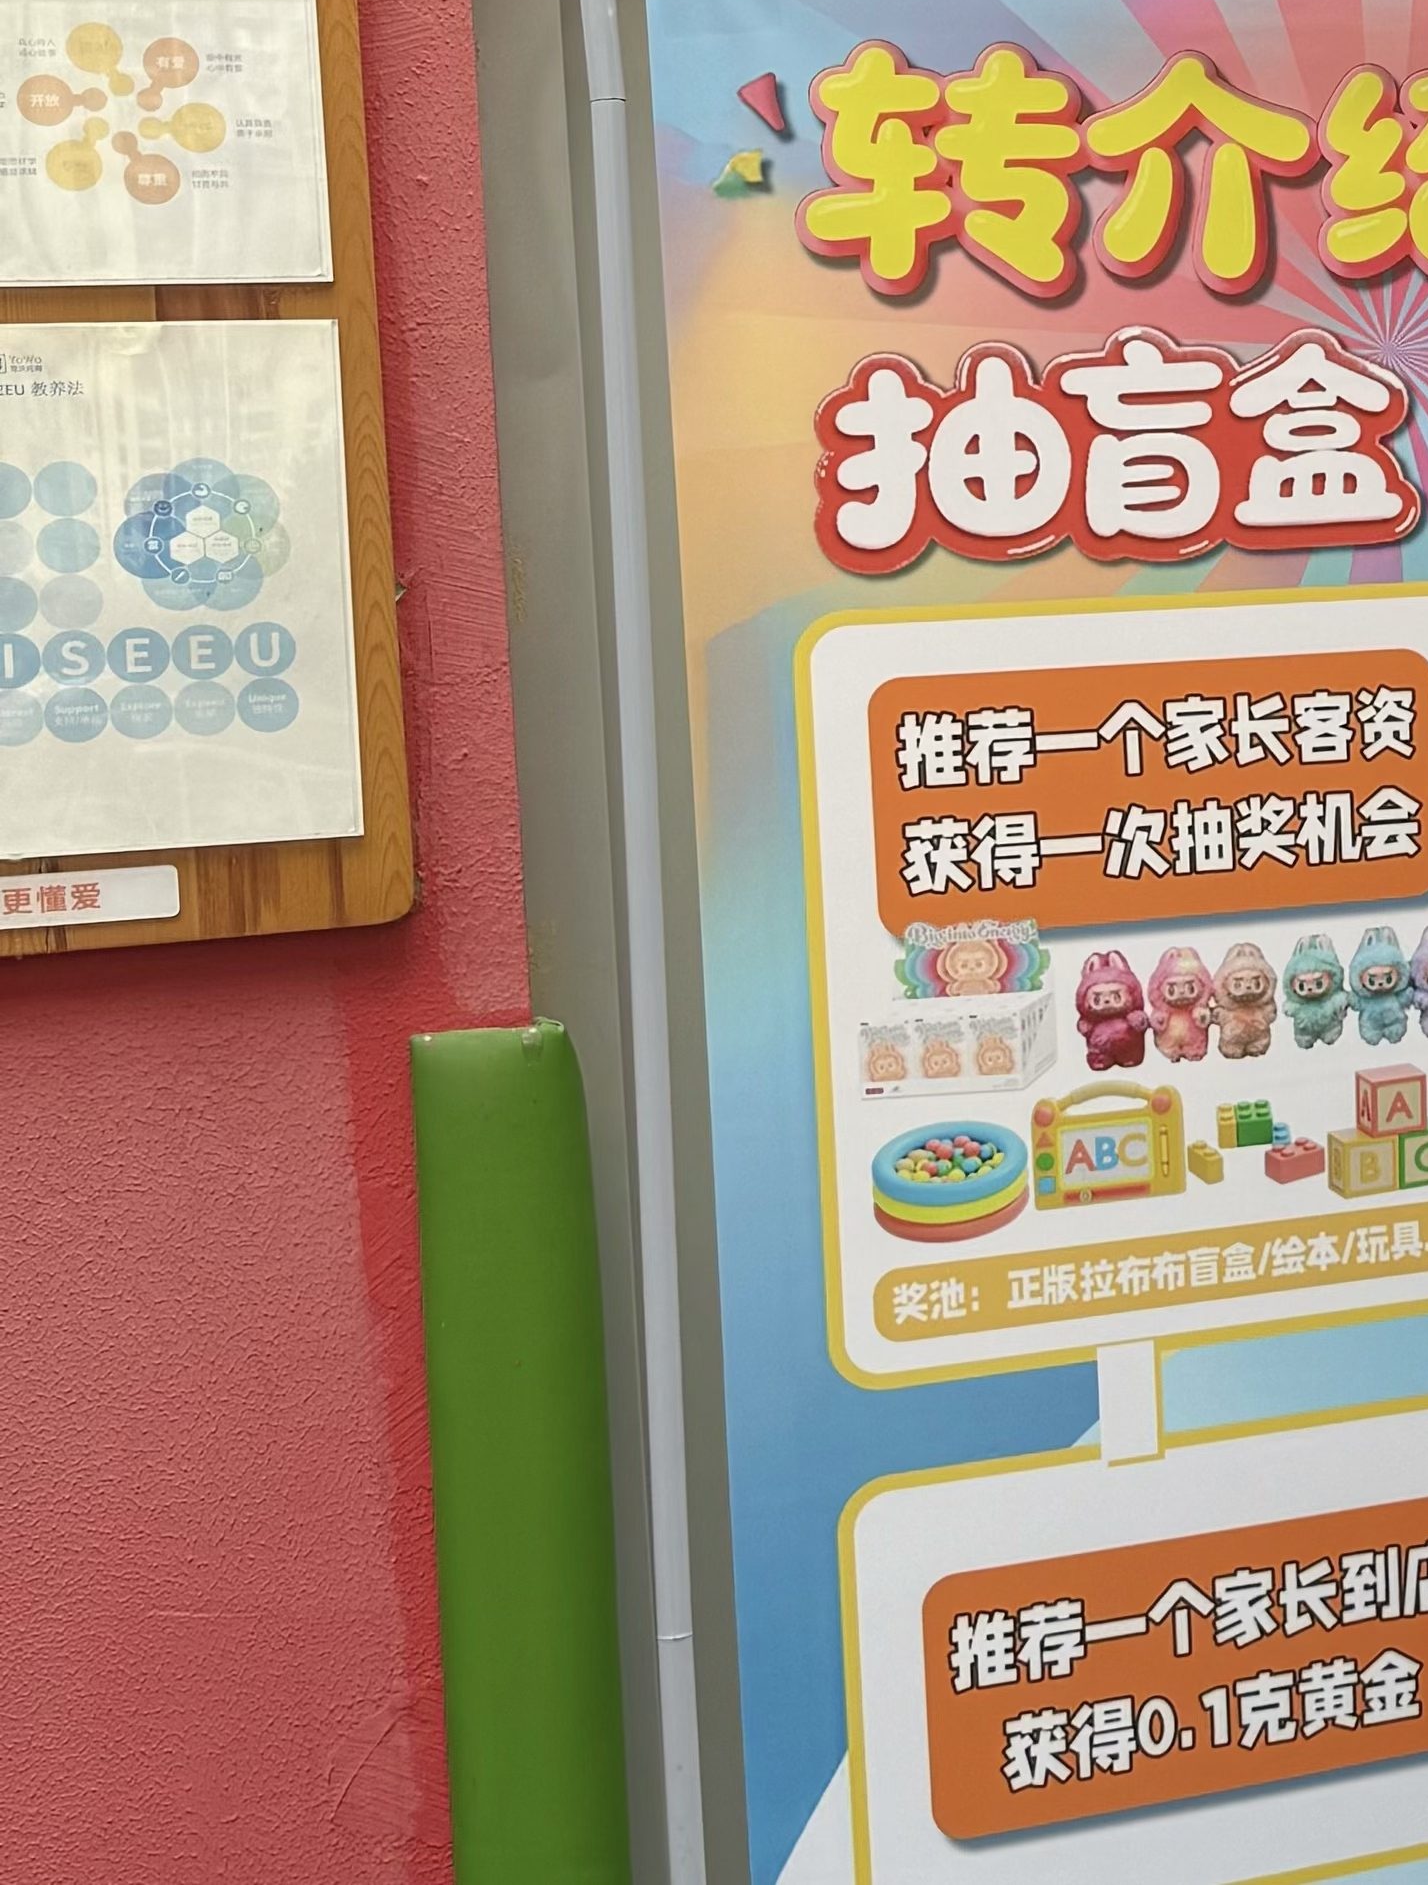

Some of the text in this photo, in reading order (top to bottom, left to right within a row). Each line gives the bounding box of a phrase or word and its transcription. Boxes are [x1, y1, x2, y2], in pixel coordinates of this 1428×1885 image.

[833, 332, 1405, 554] 抽盲盒
[896, 685, 1418, 791] 推荐一个家长客资
[901, 787, 1424, 898] 获得一次抽奖机会
[2, 882, 101, 915] 更懂爱
[1064, 1131, 1148, 1175] ABC
[1386, 1090, 1414, 1123] A
[1000, 1647, 1424, 1794] 获得0.1克黄金
